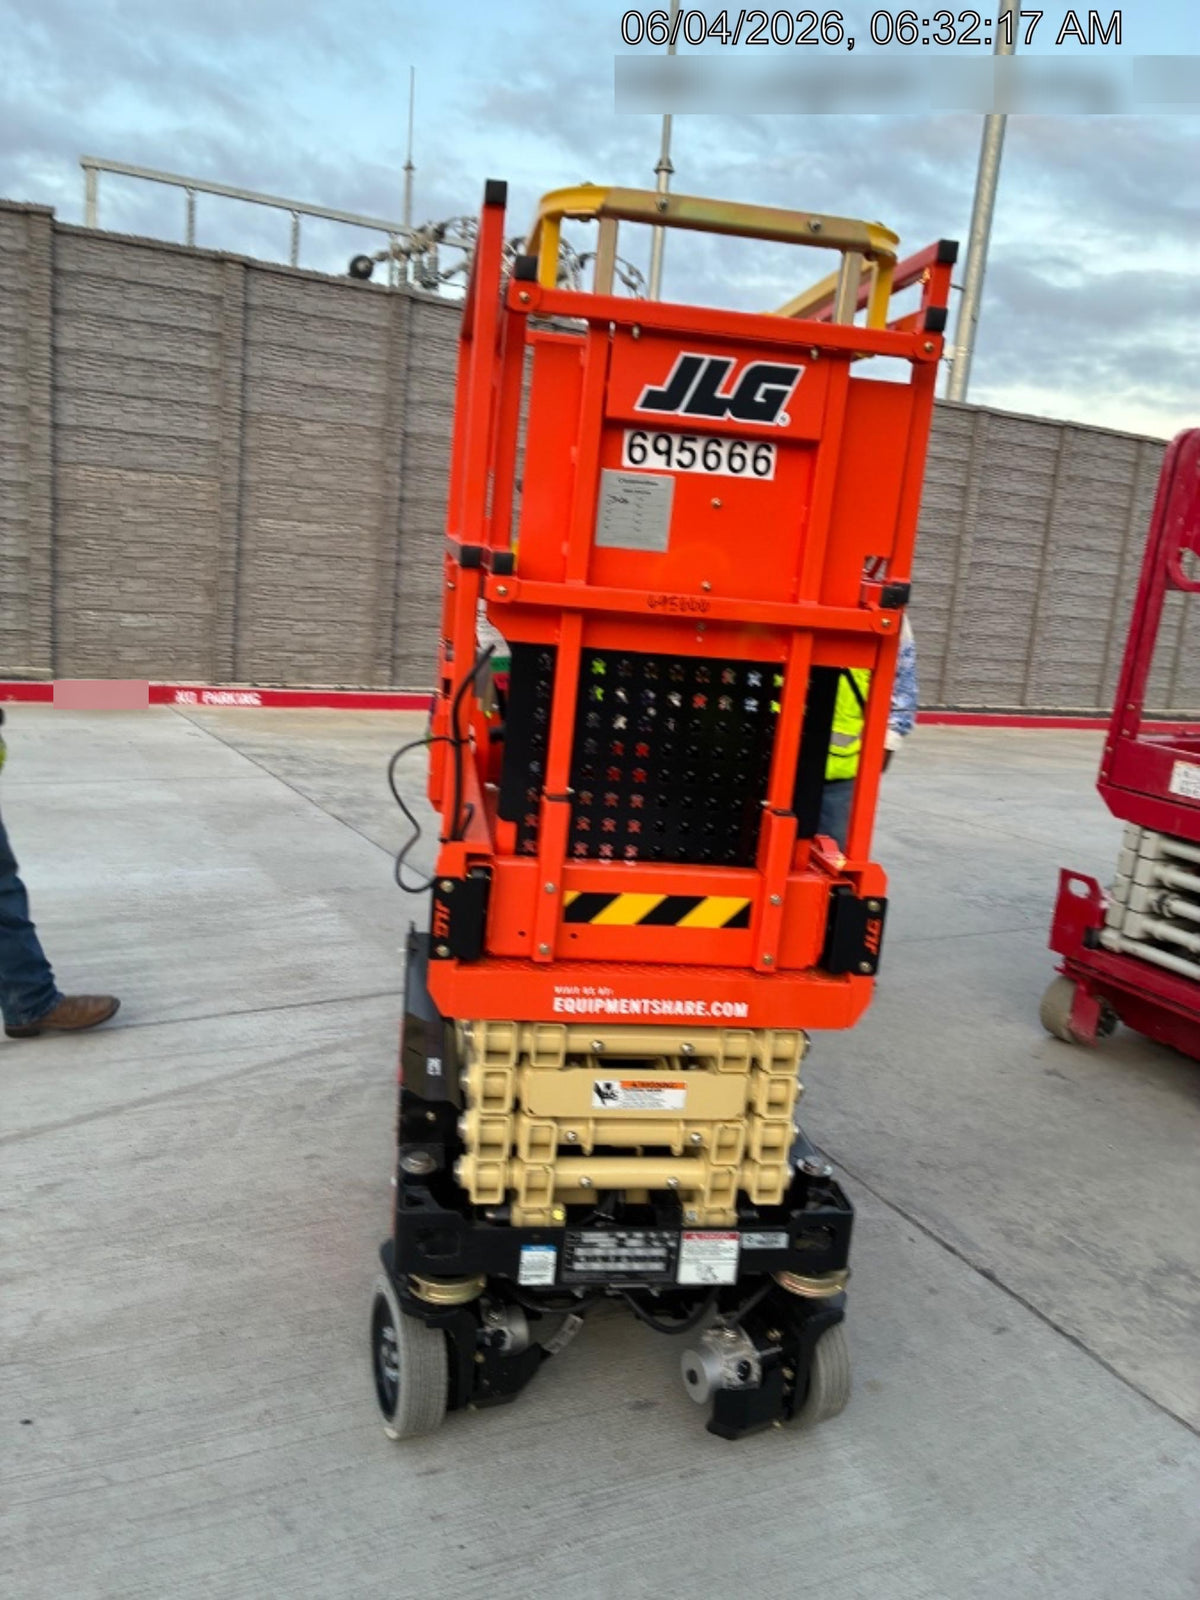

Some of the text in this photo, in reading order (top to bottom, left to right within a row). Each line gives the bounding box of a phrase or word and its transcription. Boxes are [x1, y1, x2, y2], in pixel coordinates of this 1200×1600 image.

[635, 352, 804, 426] JLG
[627, 431, 774, 476] 695666
[175, 690, 262, 706] NO PARKING
[433, 899, 450, 938] JLG
[864, 918, 882, 956] JLG
[553, 996, 749, 1018] EQUIPMENTSHARE.COM
